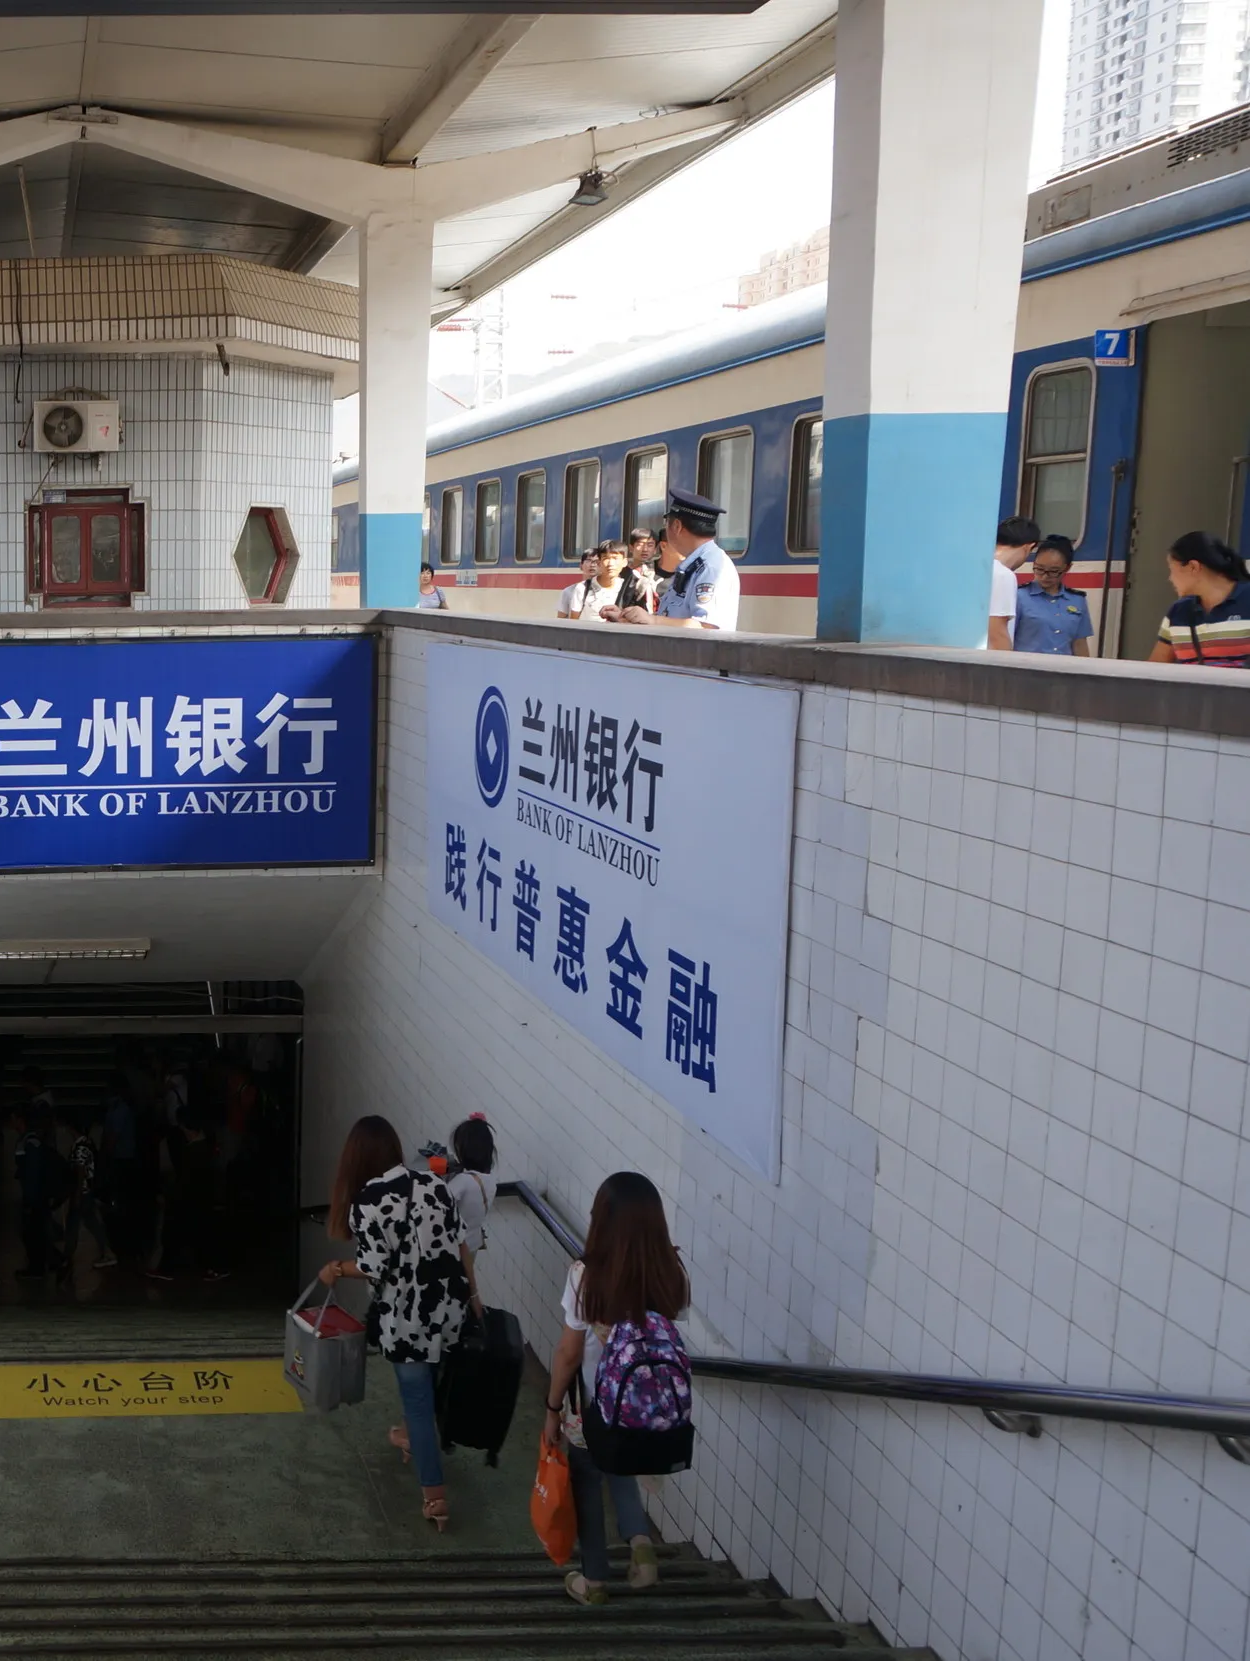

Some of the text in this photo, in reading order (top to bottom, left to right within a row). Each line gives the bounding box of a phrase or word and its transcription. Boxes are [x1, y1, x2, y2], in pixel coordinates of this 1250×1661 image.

[1105, 333, 1120, 356] 7
[518, 697, 663, 832] 兰州银行
[99, 792, 147, 817] OF
[157, 789, 336, 816] LANZHOU
[516, 797, 660, 887] BANK OF LANZHOU
[444, 822, 718, 1093] 践行普惠金融
[26, 1369, 234, 1393] 小心台阶
[42, 1395, 224, 1407] Watch your step
